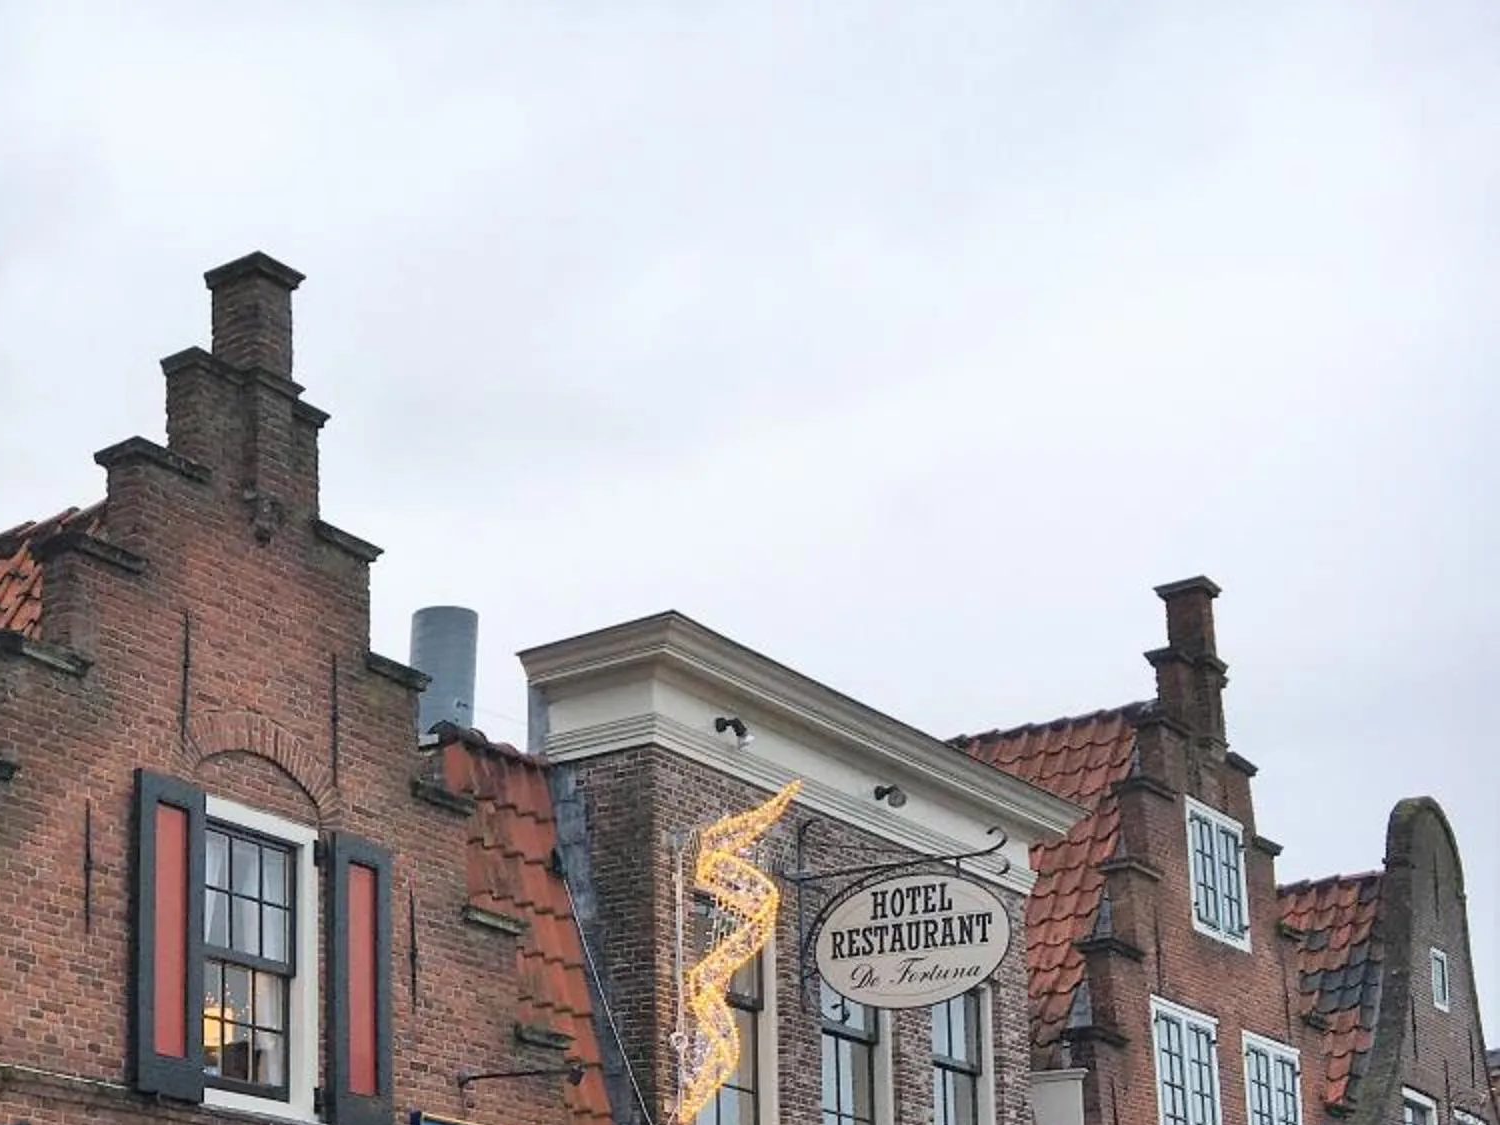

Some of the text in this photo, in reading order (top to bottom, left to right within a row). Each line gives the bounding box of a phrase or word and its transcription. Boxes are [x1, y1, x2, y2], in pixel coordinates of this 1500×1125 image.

[870, 883, 953, 920] HOTEL
[831, 912, 993, 960] RESTAURANT
[850, 956, 982, 990] De Fortuna
